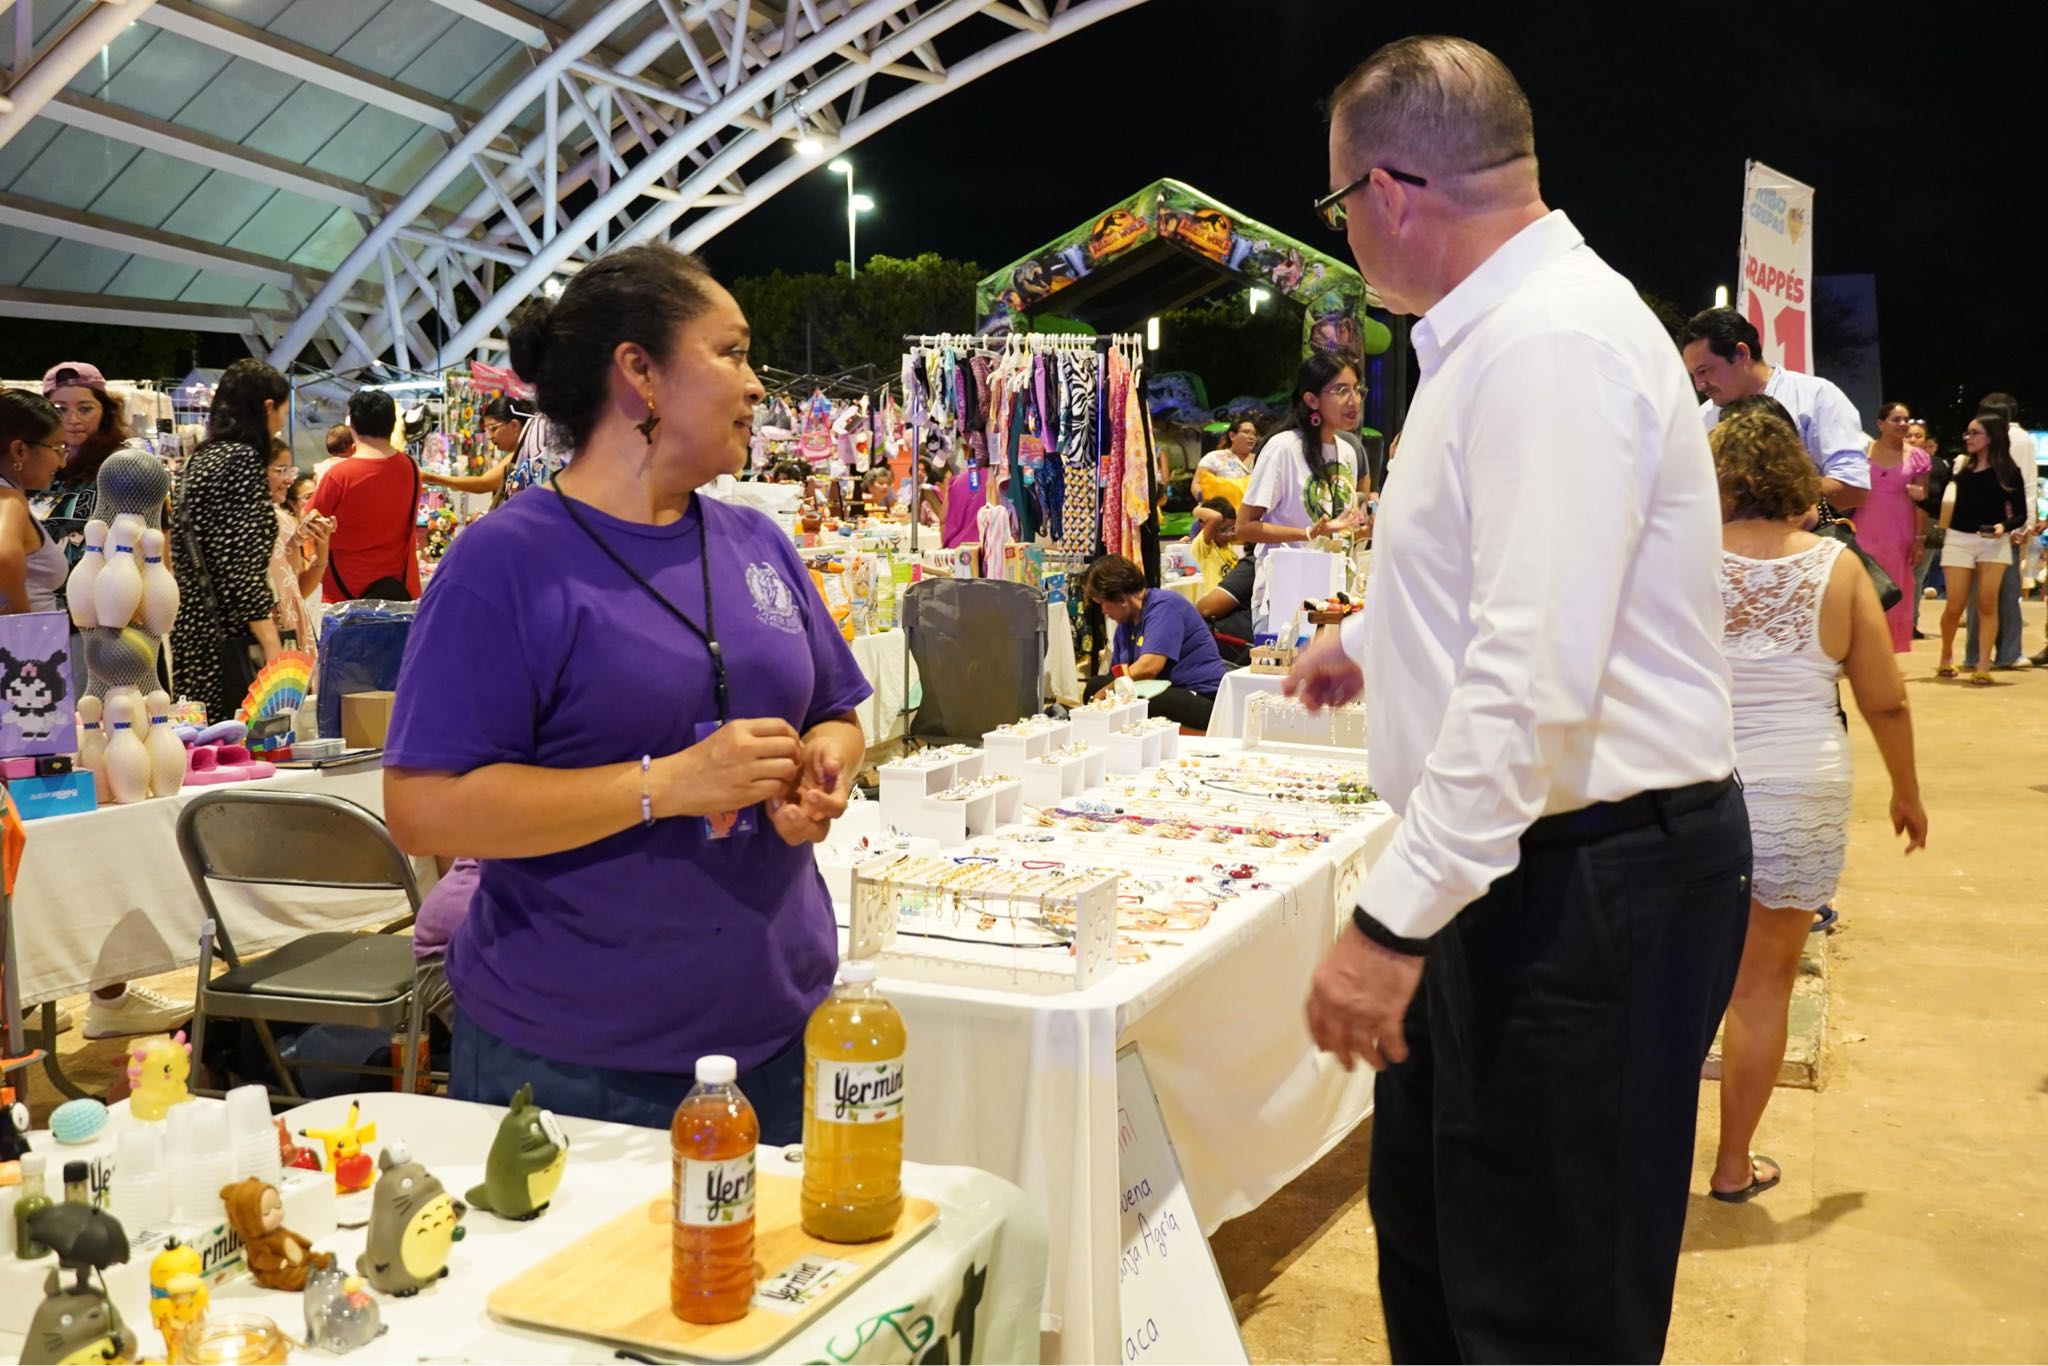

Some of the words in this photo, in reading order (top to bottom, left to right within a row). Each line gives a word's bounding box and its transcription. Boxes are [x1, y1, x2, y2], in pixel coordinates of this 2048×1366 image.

[834, 1065, 904, 1119] Yermin
[1120, 1178, 1152, 1213] uena
[760, 1262, 822, 1304] Yermint
[1125, 1317, 1160, 1362] aca
